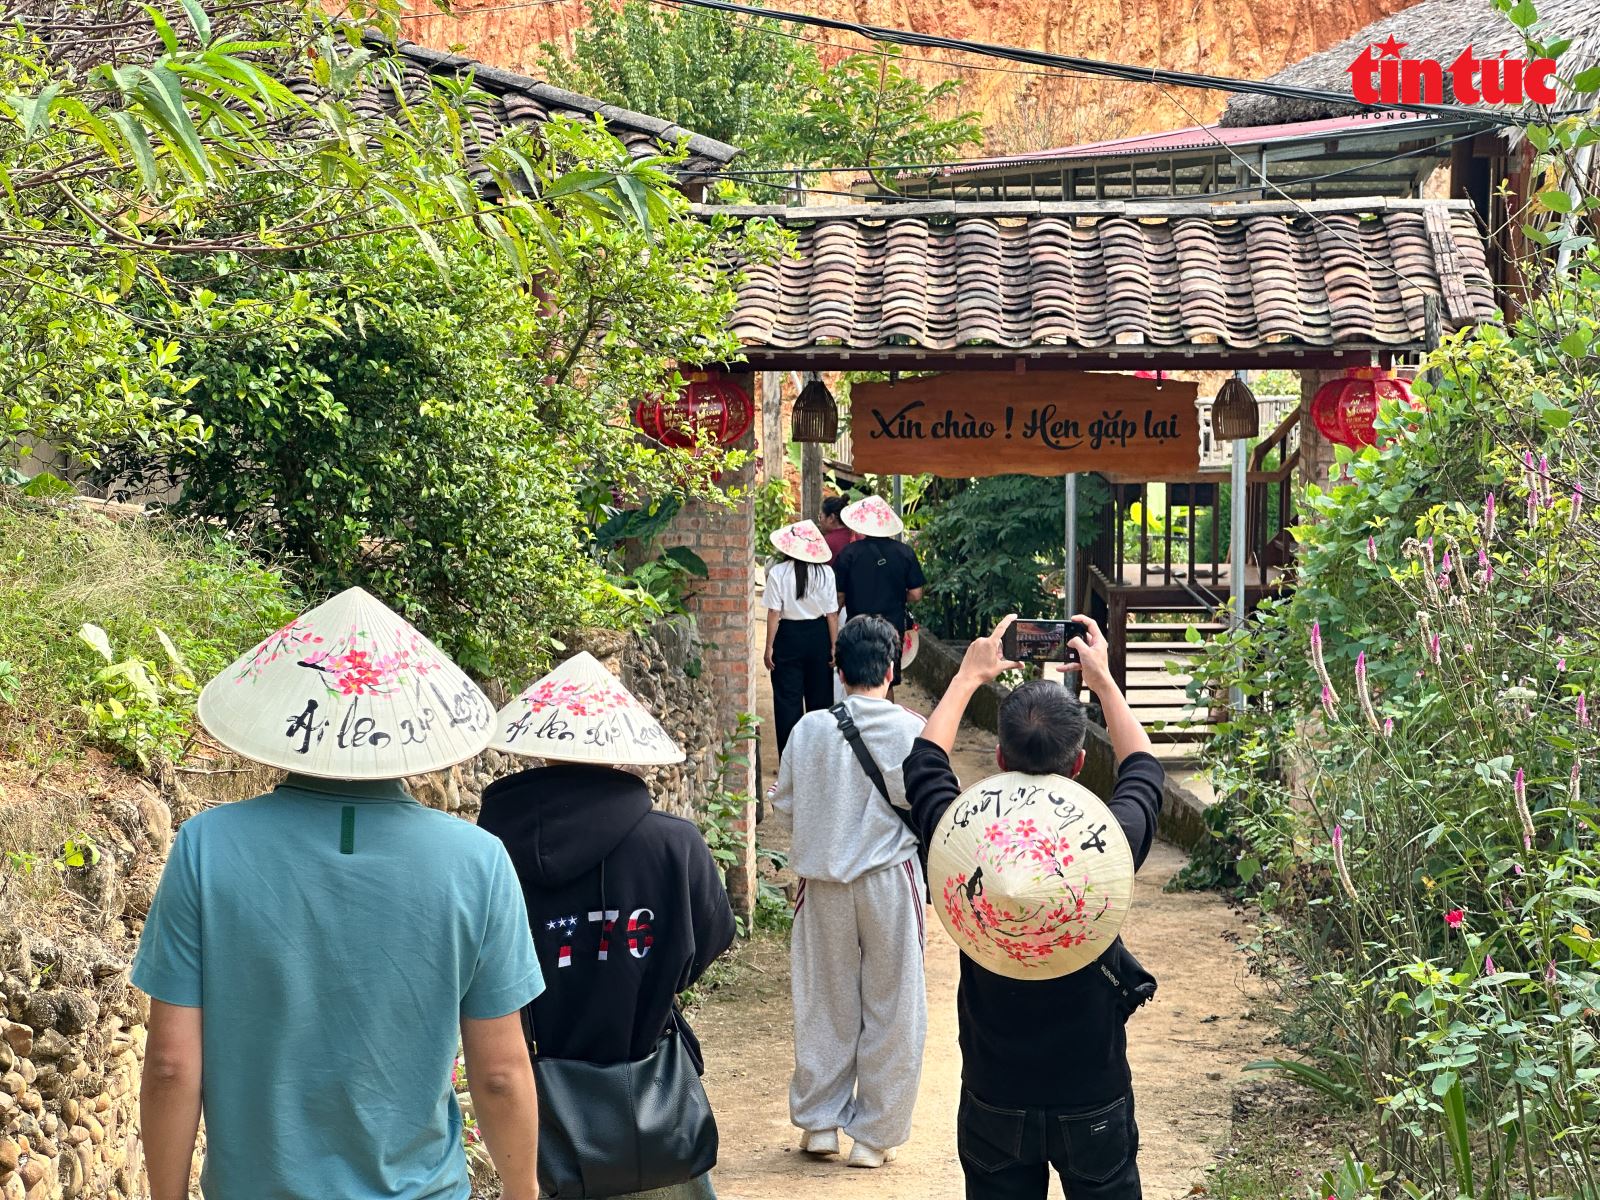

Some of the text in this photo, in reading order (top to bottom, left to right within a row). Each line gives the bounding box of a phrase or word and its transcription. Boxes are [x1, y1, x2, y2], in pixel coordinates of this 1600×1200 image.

[870, 400, 926, 440] Xin
[931, 410, 997, 440] chào
[1022, 404, 1084, 450] Hẹn
[1088, 409, 1137, 450] gặp
[1144, 410, 1181, 445] lại
[286, 700, 329, 754] Ai
